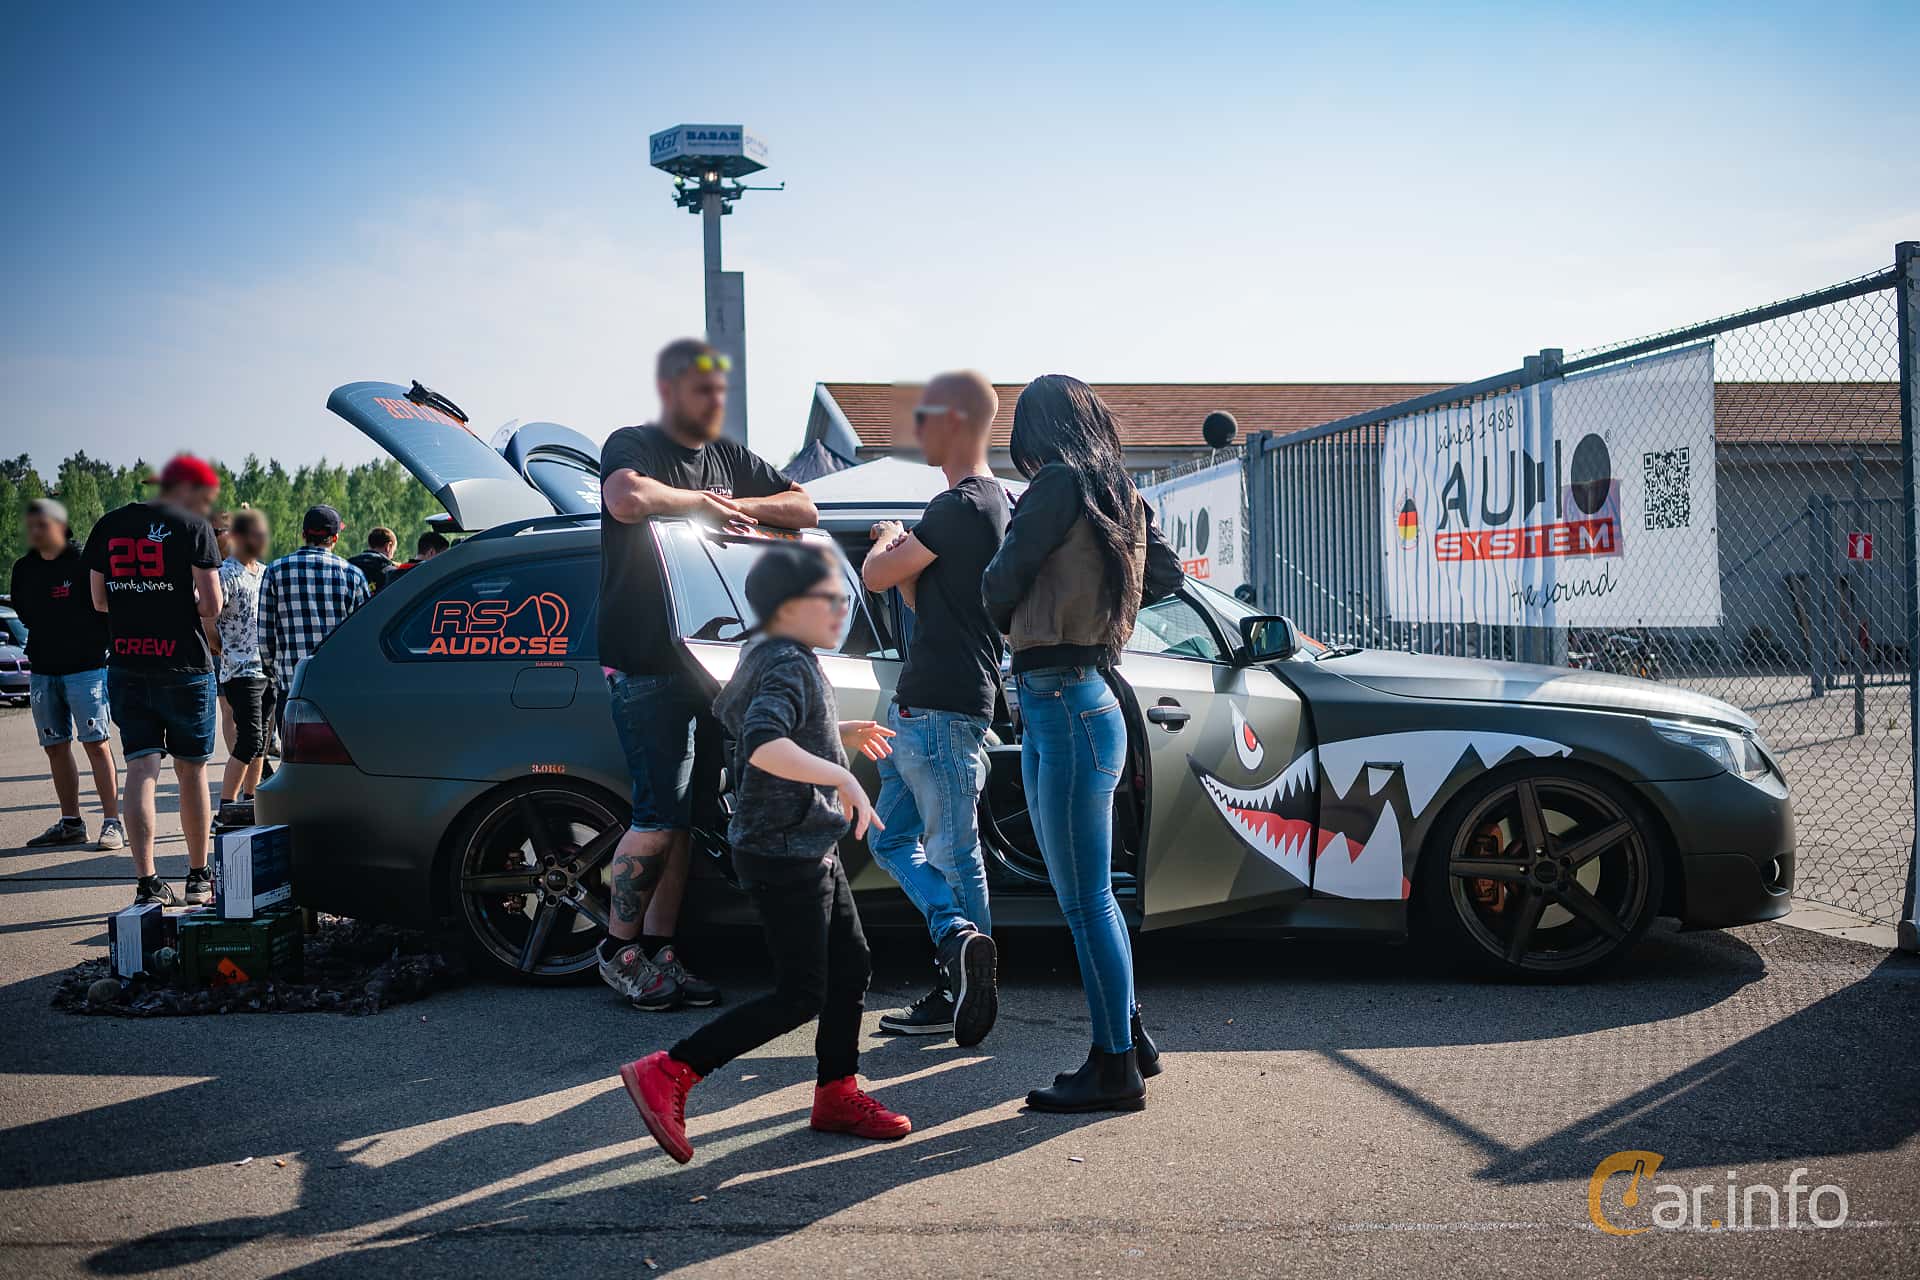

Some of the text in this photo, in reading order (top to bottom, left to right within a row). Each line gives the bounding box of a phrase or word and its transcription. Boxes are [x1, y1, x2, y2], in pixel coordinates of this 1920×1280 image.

[1480, 406, 1514, 439] 1988
[108, 537, 165, 577] 29
[1437, 522, 1611, 559] SYSTEM
[1542, 561, 1618, 609] sound
[431, 600, 509, 634] RS
[114, 638, 176, 657] CREW
[427, 636, 569, 655] AUDIO.SE
